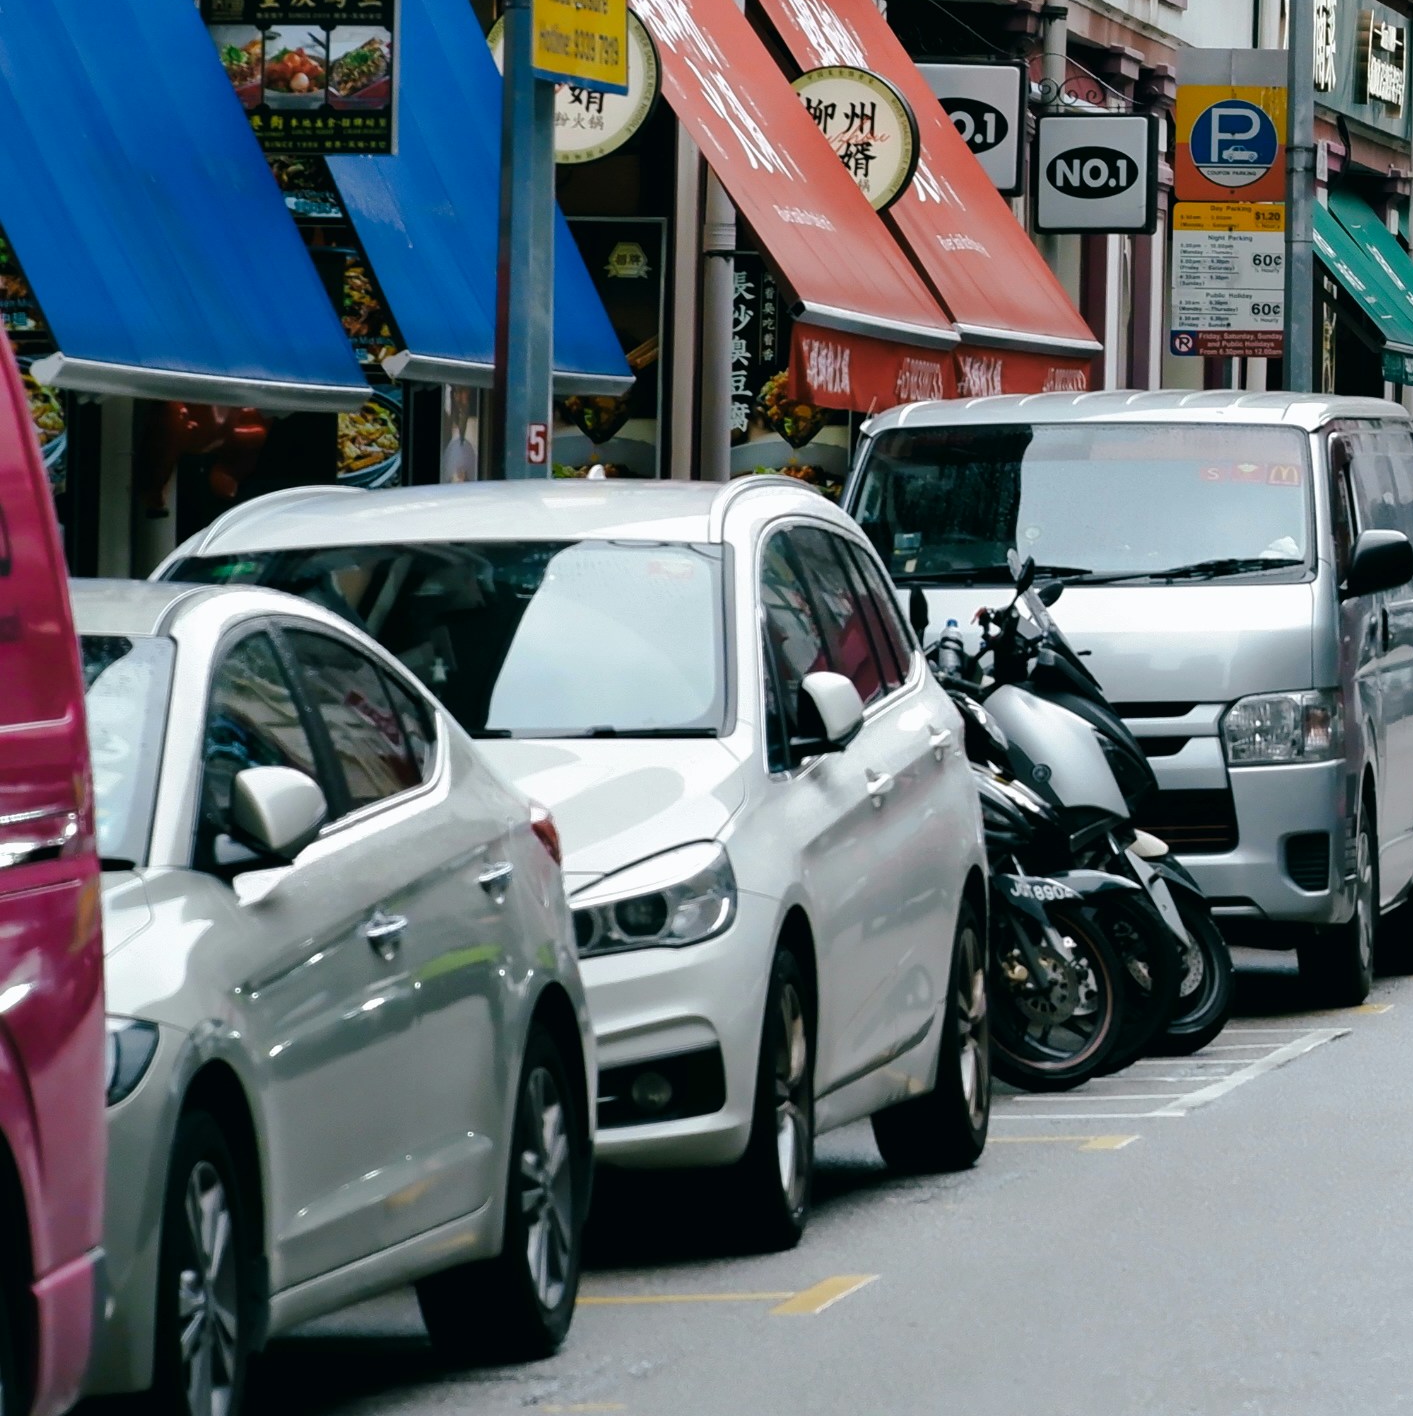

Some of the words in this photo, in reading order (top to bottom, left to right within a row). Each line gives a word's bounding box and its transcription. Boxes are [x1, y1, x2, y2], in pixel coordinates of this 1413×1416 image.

[951, 111, 996, 144] O.1
[1210, 108, 1260, 162] P
[1055, 158, 1127, 188] NO.1
[1226, 205, 1252, 213] Parking
[1255, 212, 1281, 221] $1.20
[1208, 235, 1225, 243] Night
[1228, 235, 1253, 243] Parking
[1253, 254, 1282, 267] 60¢
[1251, 303, 1281, 316] 60¢
[530, 424, 545, 463] 5
